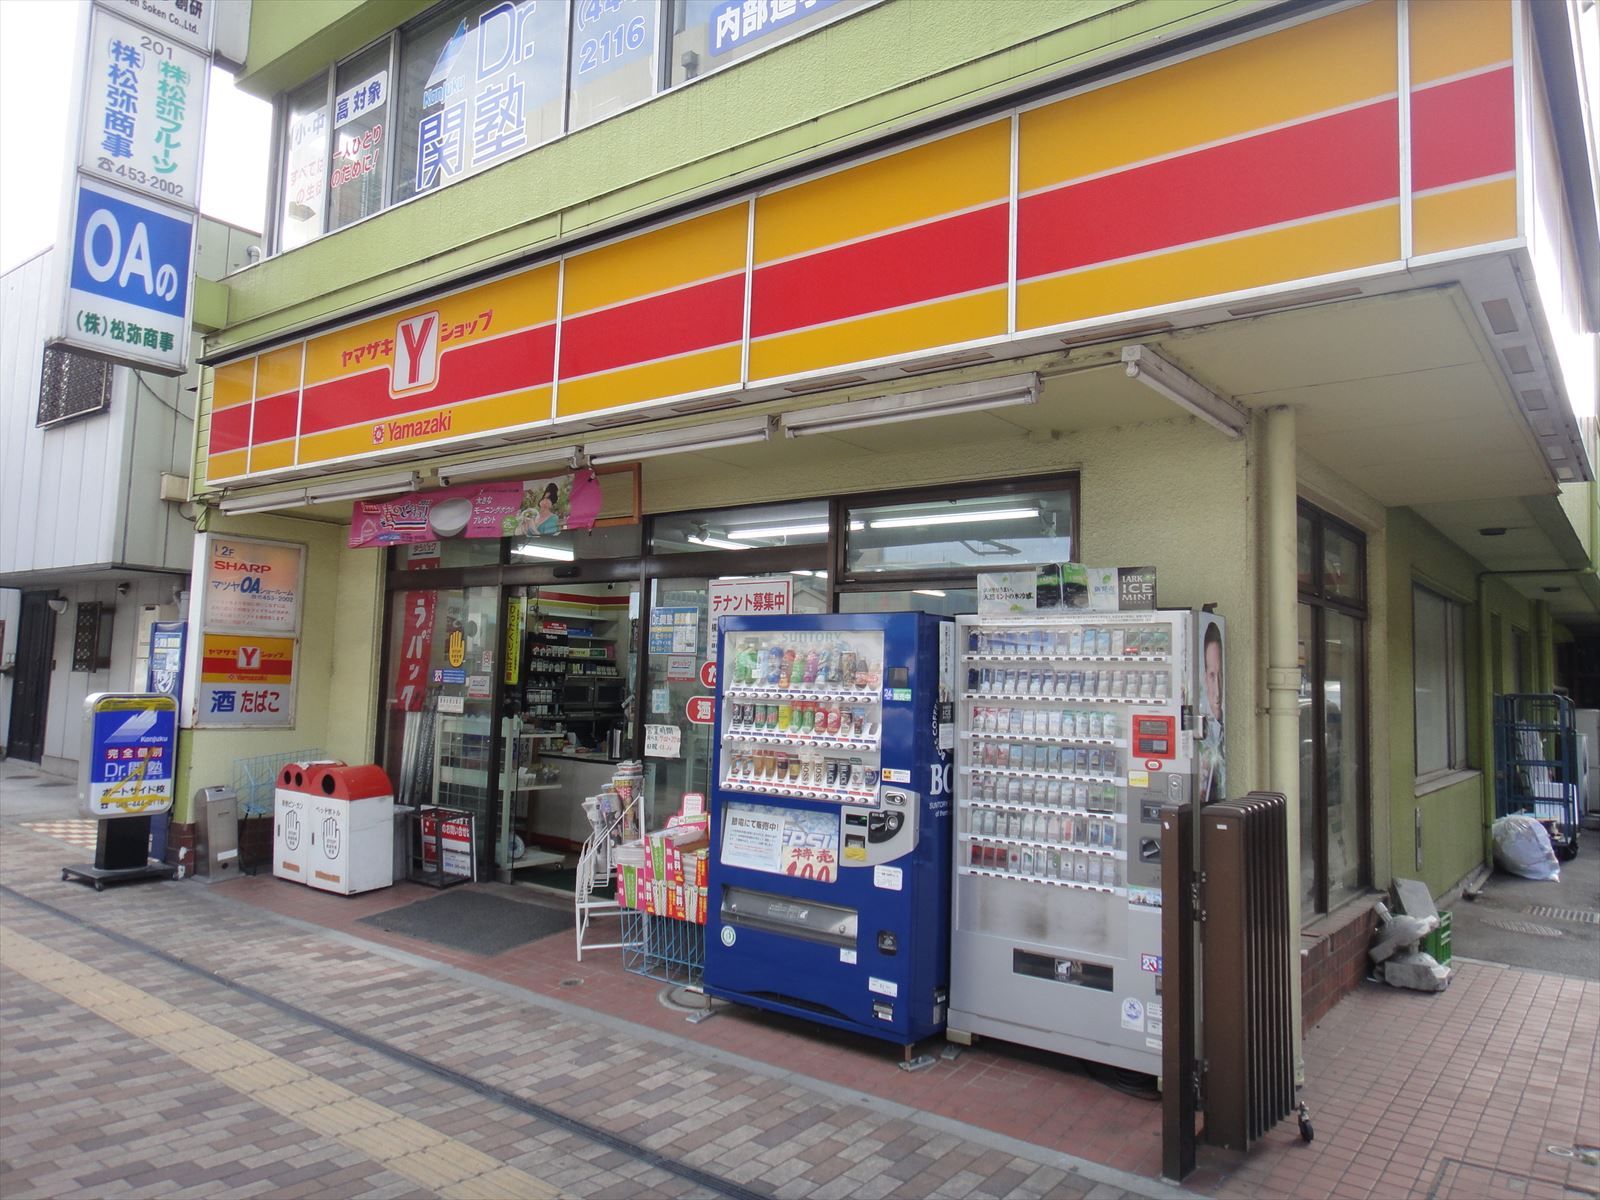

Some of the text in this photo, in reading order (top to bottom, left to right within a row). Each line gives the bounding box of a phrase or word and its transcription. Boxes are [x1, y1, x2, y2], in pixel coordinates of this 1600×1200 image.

[142, 1, 167, 20] Soken
[140, 36, 174, 60] 201
[475, 1, 536, 84] Dr.
[578, 15, 646, 75] 2116
[101, 37, 145, 158] (株)松弥商事
[152, 59, 191, 174] (株)松弥フルーツ
[333, 124, 383, 160] 一人ひとり
[415, 74, 528, 193] 関塾
[115, 164, 184, 199] 453-2002
[83, 208, 178, 302] OAの
[76, 310, 175, 352] (株)松弥商事
[341, 308, 494, 385] ヤマザキ Y ショップ
[388, 410, 452, 442] Yamazaki
[221, 546, 235, 557] 2F
[213, 560, 272, 574] SHARP
[1122, 575, 1143, 583] LARK
[1122, 583, 1153, 593] ICE
[1122, 593, 1154, 601] MINT
[712, 592, 785, 613] テナント募集中
[781, 631, 842, 644] SUNTORY
[241, 647, 258, 667] Y
[211, 690, 280, 713] 酒 たばこ
[815, 762, 823, 783] BOSS
